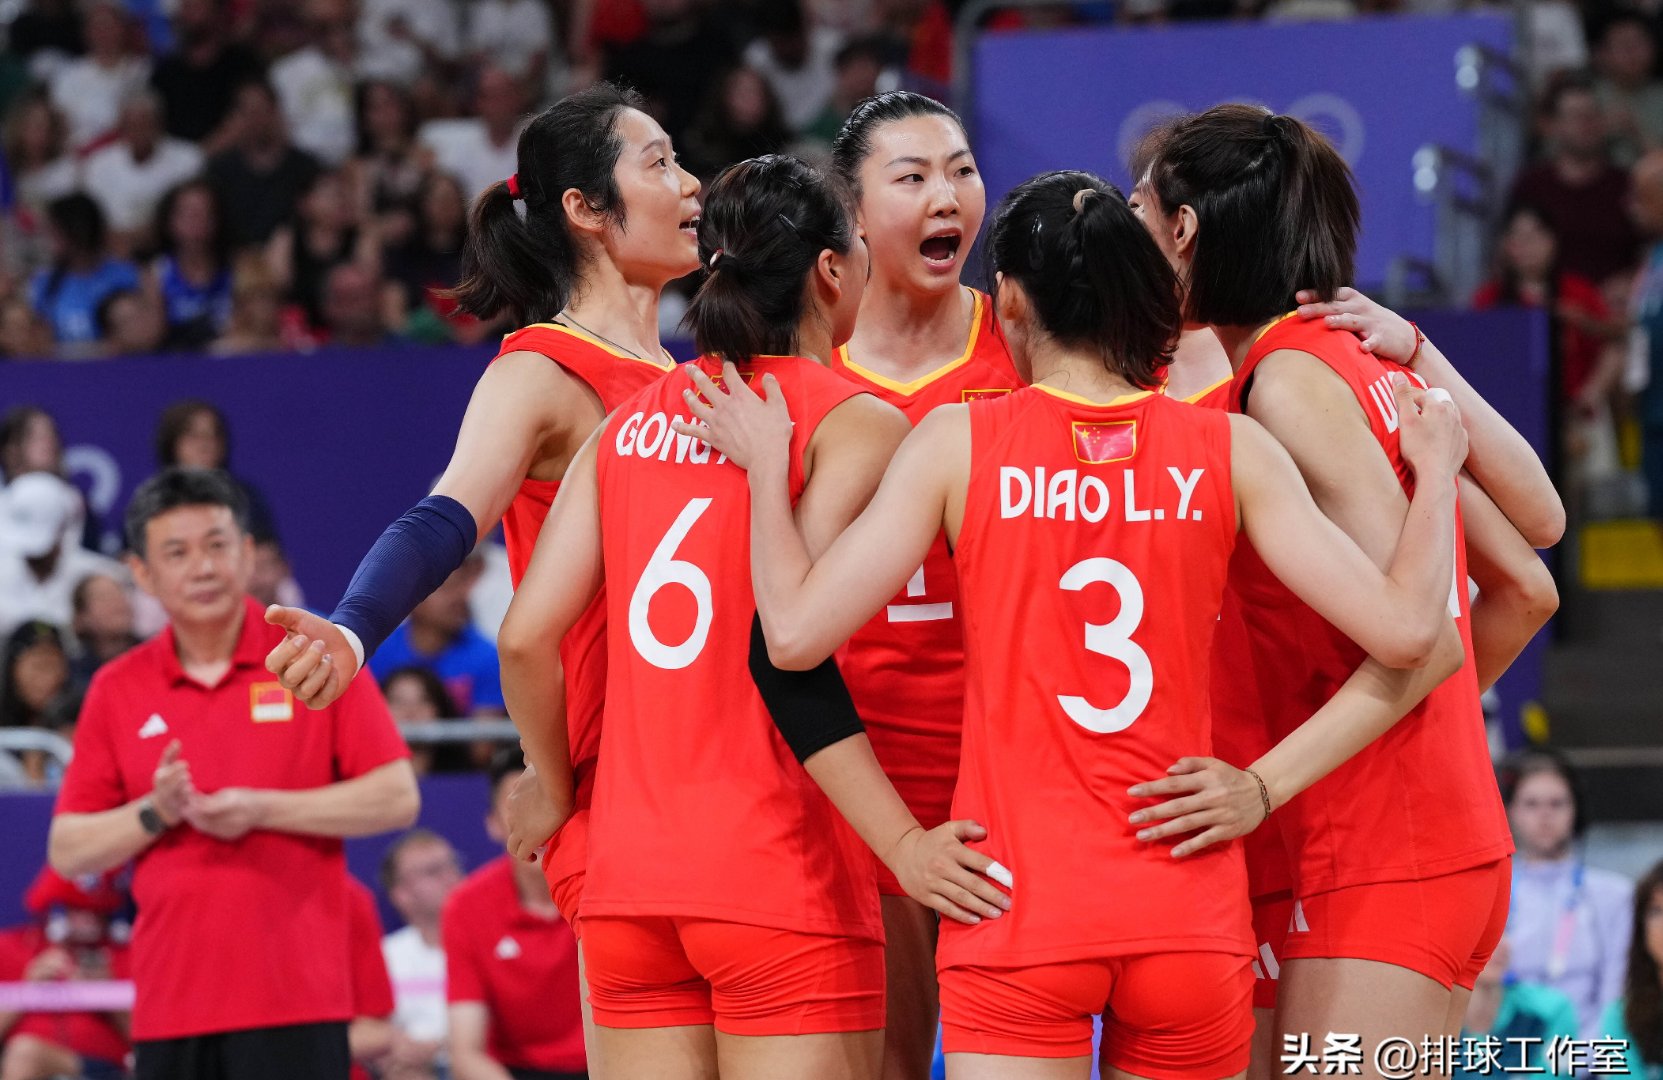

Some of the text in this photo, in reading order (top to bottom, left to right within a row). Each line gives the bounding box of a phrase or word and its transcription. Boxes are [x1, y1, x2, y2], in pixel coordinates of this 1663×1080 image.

[1000, 466, 1205, 523] DIAO L.Y.
[628, 497, 714, 670] 6
[1056, 557, 1154, 734] 3
